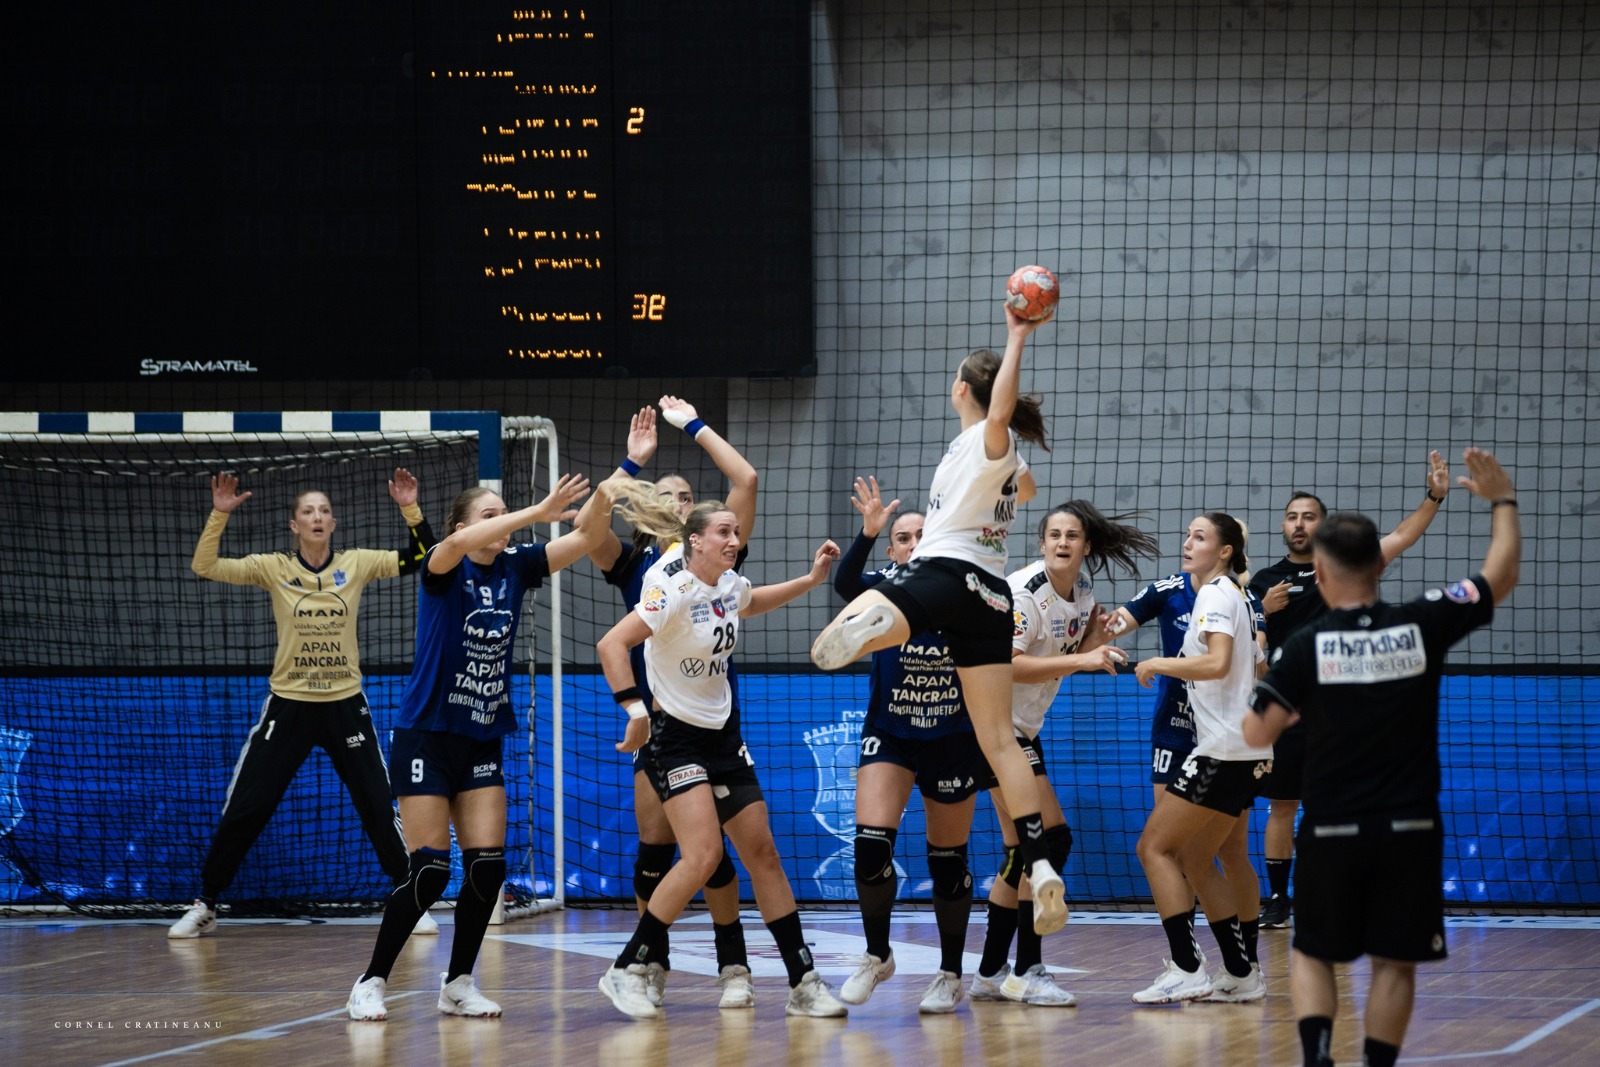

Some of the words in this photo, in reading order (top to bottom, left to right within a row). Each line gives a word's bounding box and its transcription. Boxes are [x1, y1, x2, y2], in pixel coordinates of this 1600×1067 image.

[626, 107, 645, 134] 2
[479, 586, 493, 606] 9
[298, 608, 344, 617] MAN
[300, 641, 341, 653] APAN
[712, 622, 735, 655] 28
[293, 655, 348, 667] TANCRAD
[466, 660, 506, 678] APAN
[902, 673, 953, 688] APAN
[891, 686, 959, 703] TANCRAD
[411, 758, 424, 783] 9
[1181, 755, 1199, 779] 4
